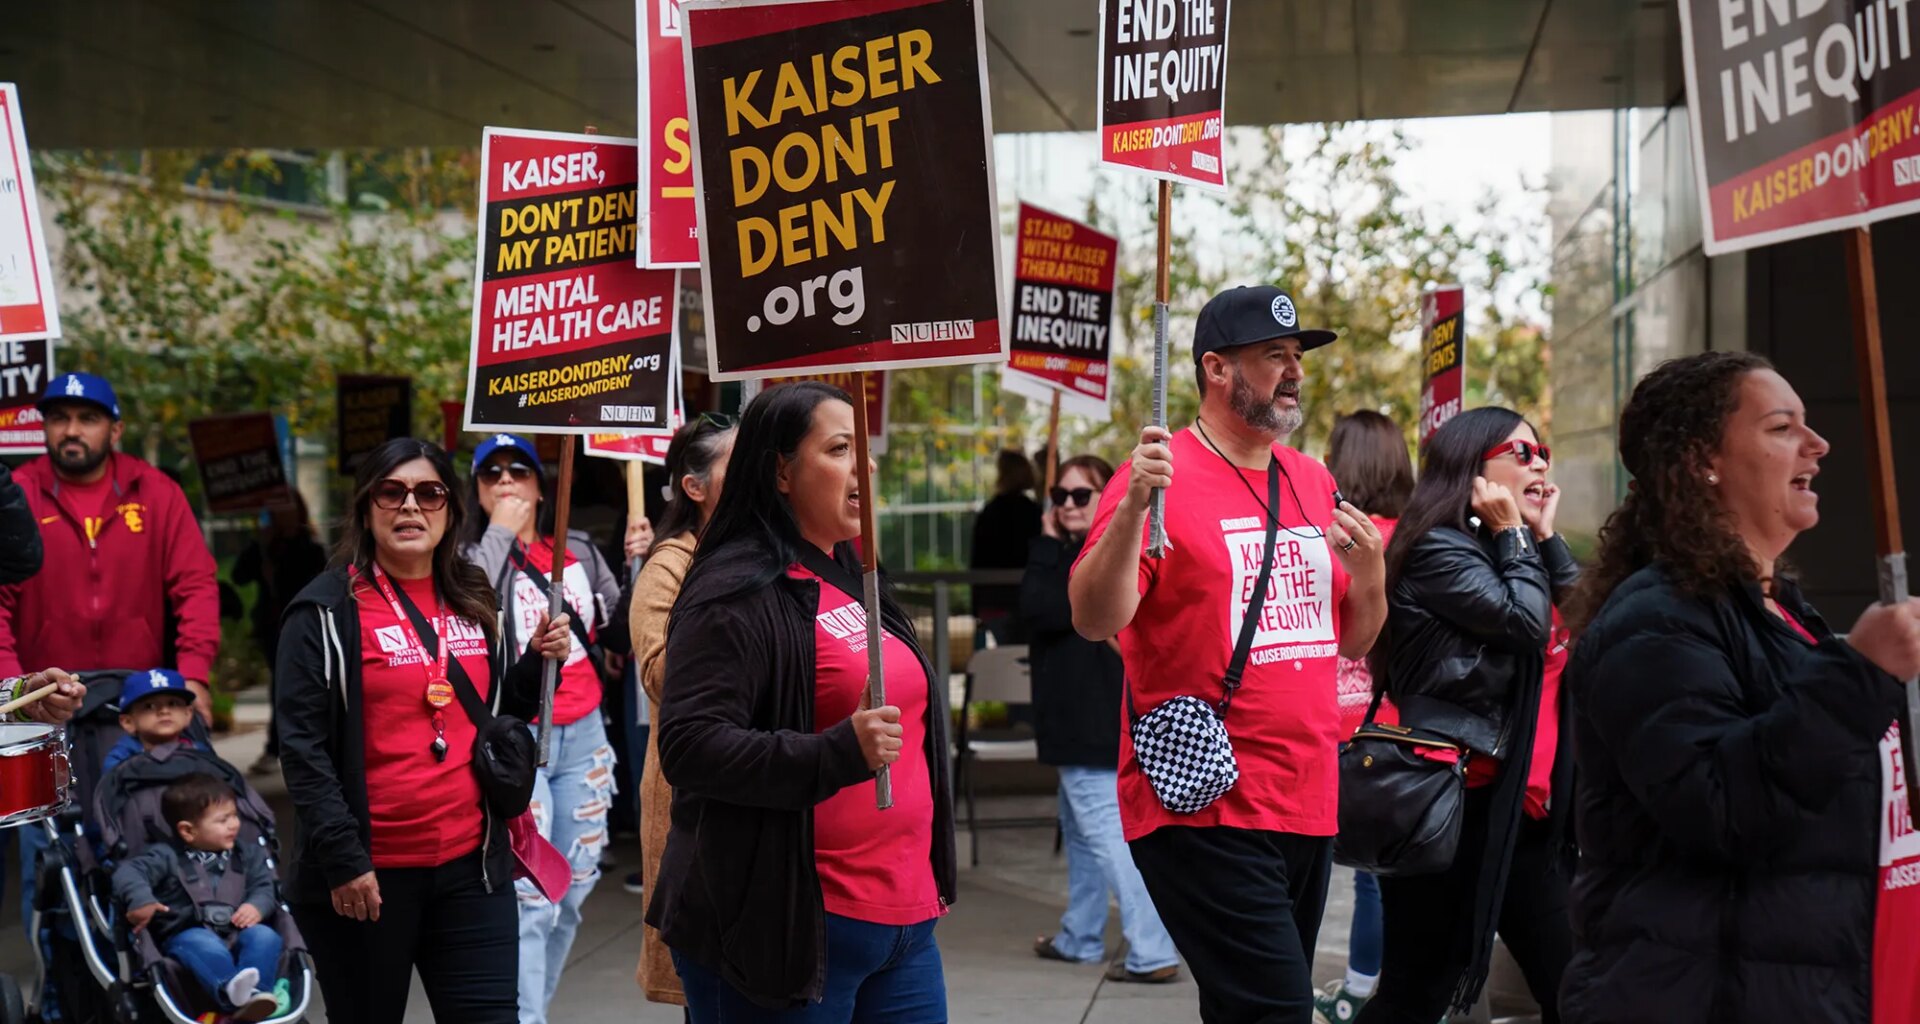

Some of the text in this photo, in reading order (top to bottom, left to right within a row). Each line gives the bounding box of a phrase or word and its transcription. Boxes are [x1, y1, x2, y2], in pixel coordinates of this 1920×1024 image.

[1117, 0, 1215, 44] END THE
[1718, 0, 1826, 50] EN
[722, 28, 943, 137] KAISER
[1113, 44, 1222, 103] INEQUITY
[1112, 117, 1220, 154] KAISERDONTDENY.ORG
[502, 151, 606, 192] KAISER,
[730, 106, 900, 208] DONT
[500, 189, 637, 238] DON'T DEN
[737, 179, 897, 279] DENY
[1024, 218, 1074, 240] STAND
[497, 238, 540, 273] MY
[1020, 257, 1099, 286] THERAPISTS
[1022, 238, 1108, 266] WITH KAISER
[493, 275, 599, 319] MENTAL
[746, 266, 866, 333] .org
[1020, 284, 1101, 322] END THE
[492, 296, 663, 353] HEALTH CARE
[890, 319, 975, 344] NUHW
[1016, 314, 1108, 351] INEQUITY
[488, 353, 661, 396] KAISERDONTDENY.org
[518, 374, 632, 408] #KAISERDONTDENY
[600, 405, 656, 422] NUHW
[1241, 574, 1277, 603] ED
[1280, 569, 1316, 599] THE
